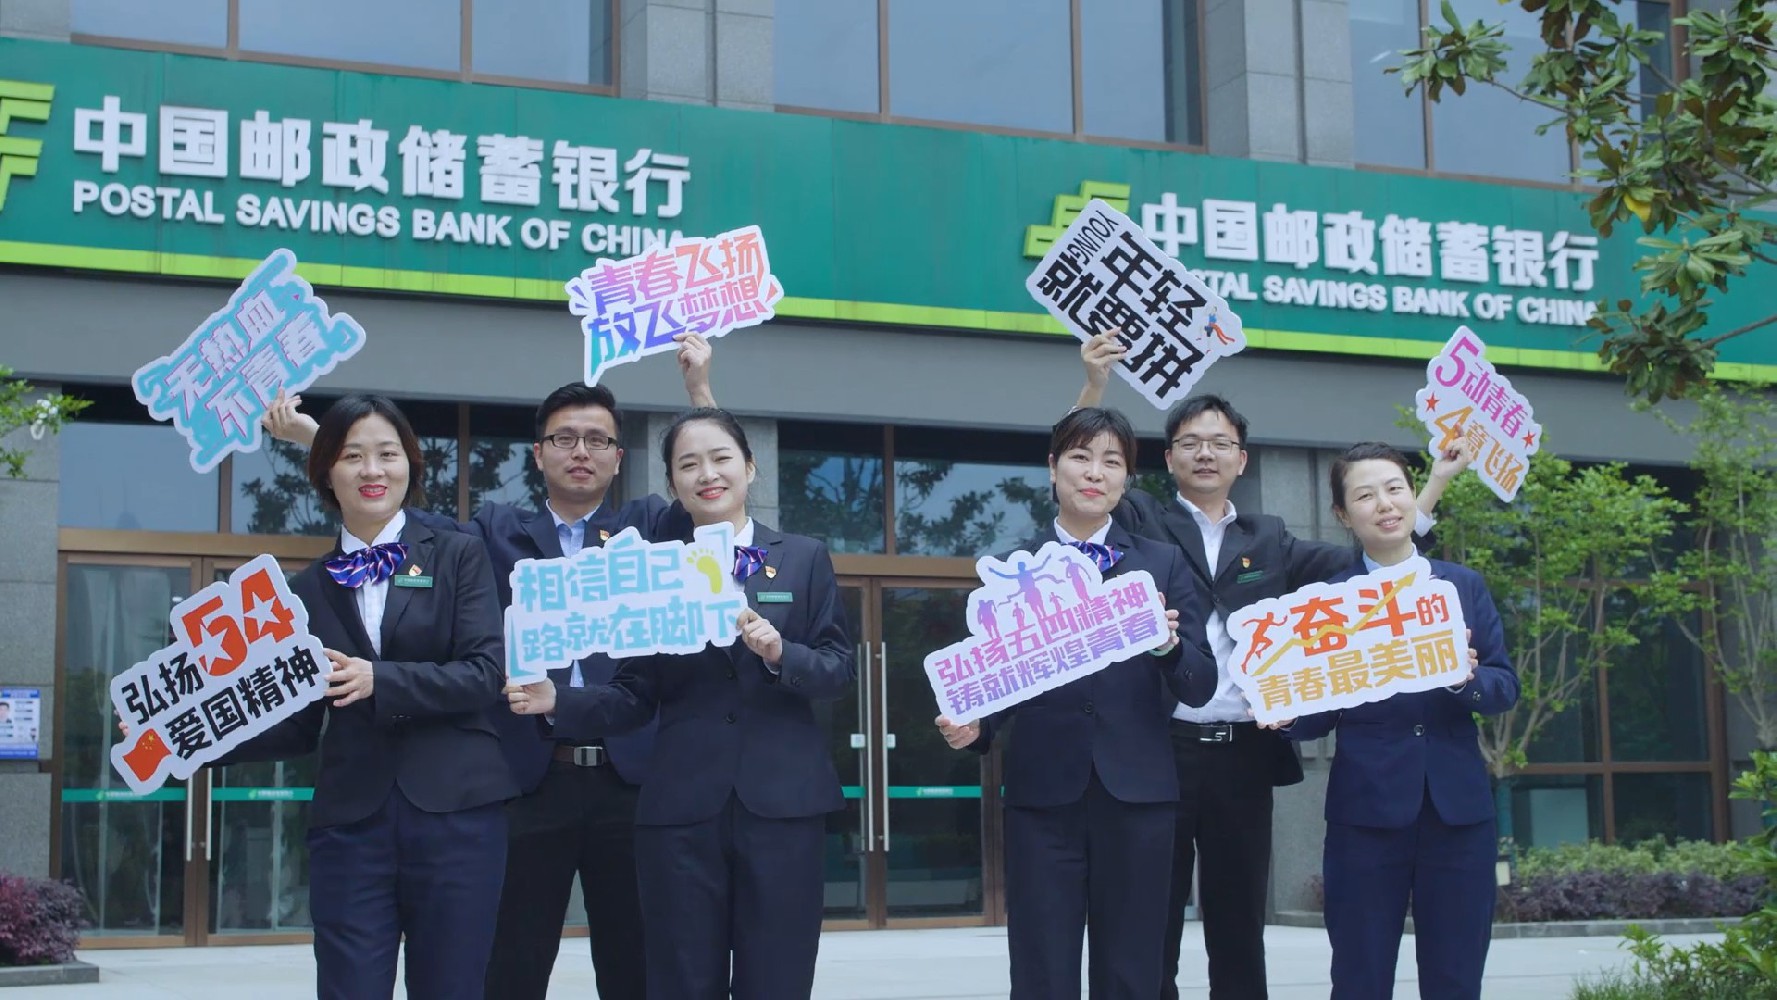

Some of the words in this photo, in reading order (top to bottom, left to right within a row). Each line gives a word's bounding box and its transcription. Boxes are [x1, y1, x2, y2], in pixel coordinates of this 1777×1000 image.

[73, 95, 691, 218] 中国邮政储蓄银行
[73, 180, 225, 224] POSTAL
[236, 192, 401, 239] SAVINGS
[412, 208, 511, 247] BANK
[520, 217, 571, 250] OF
[1067, 210, 1118, 265] YOUNG
[1142, 192, 1599, 292] 中国邮政储蓄银行
[588, 232, 765, 315] 青春飞扬
[1101, 231, 1207, 360] 年轻
[1263, 275, 1387, 313] SAVINGS
[1392, 286, 1469, 318] BANK
[1473, 293, 1513, 322] OF
[163, 289, 286, 421] 无热血
[204, 311, 327, 438] 不青春
[588, 275, 768, 378] 放飞梦想
[1036, 251, 1192, 399] 就要拼
[1435, 336, 1529, 438] 5动青春
[1434, 406, 1524, 494] 4意飞扬
[517, 534, 684, 613] 相信自己
[1290, 580, 1449, 657] 奋斗的
[521, 595, 742, 663] 路就在脚下
[934, 581, 1149, 688] 弘扬五四精神
[946, 609, 1159, 715] 铸就辉煌青春
[1256, 629, 1459, 711] 青春最美丽
[164, 645, 321, 760] 爱国精神
